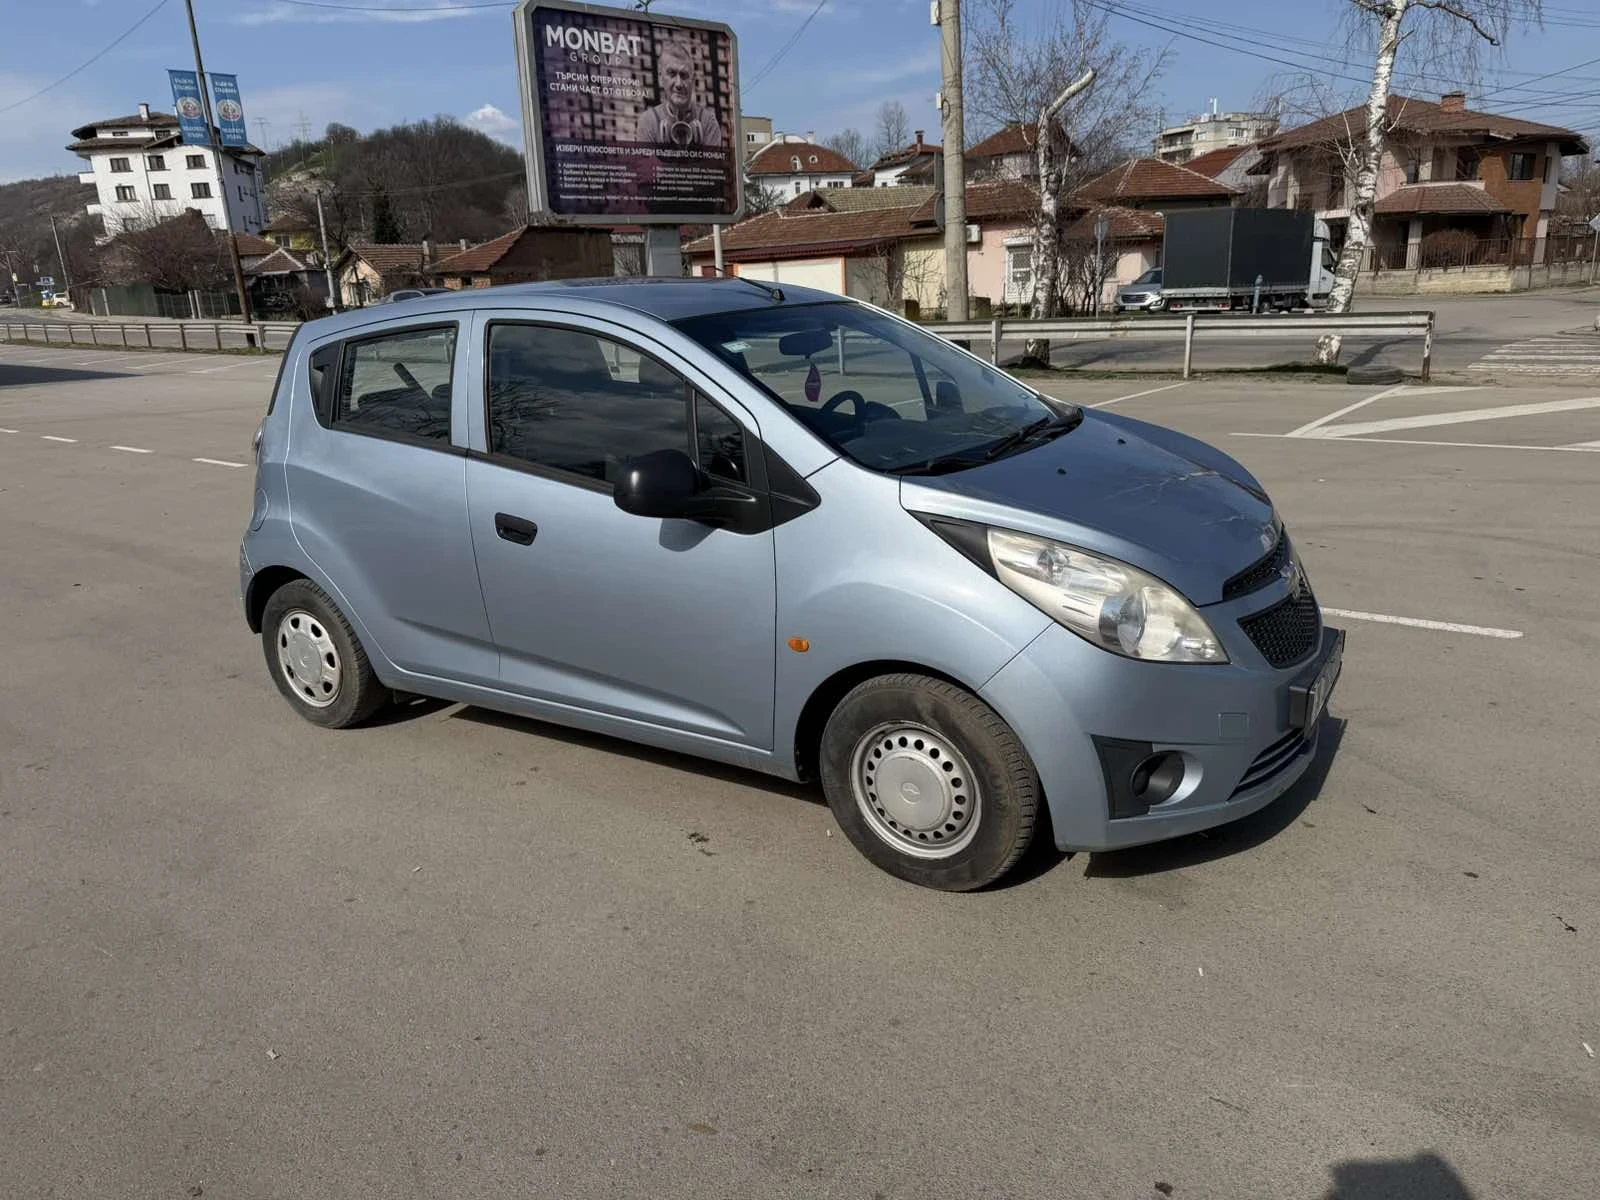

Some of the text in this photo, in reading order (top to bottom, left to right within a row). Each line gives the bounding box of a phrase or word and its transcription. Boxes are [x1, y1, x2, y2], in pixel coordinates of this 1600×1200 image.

[545, 24, 641, 56] MONBAT
[569, 52, 622, 65] GROUP
[555, 71, 589, 81] ТЪРСИМ
[549, 82, 578, 92] СТАНИ
[579, 84, 601, 94] ЧАСТ
[602, 87, 615, 96] ОТ
[556, 144, 582, 152] ИЗБЕРИ
[583, 145, 624, 154] ПЛЮСОВЕТЕ
